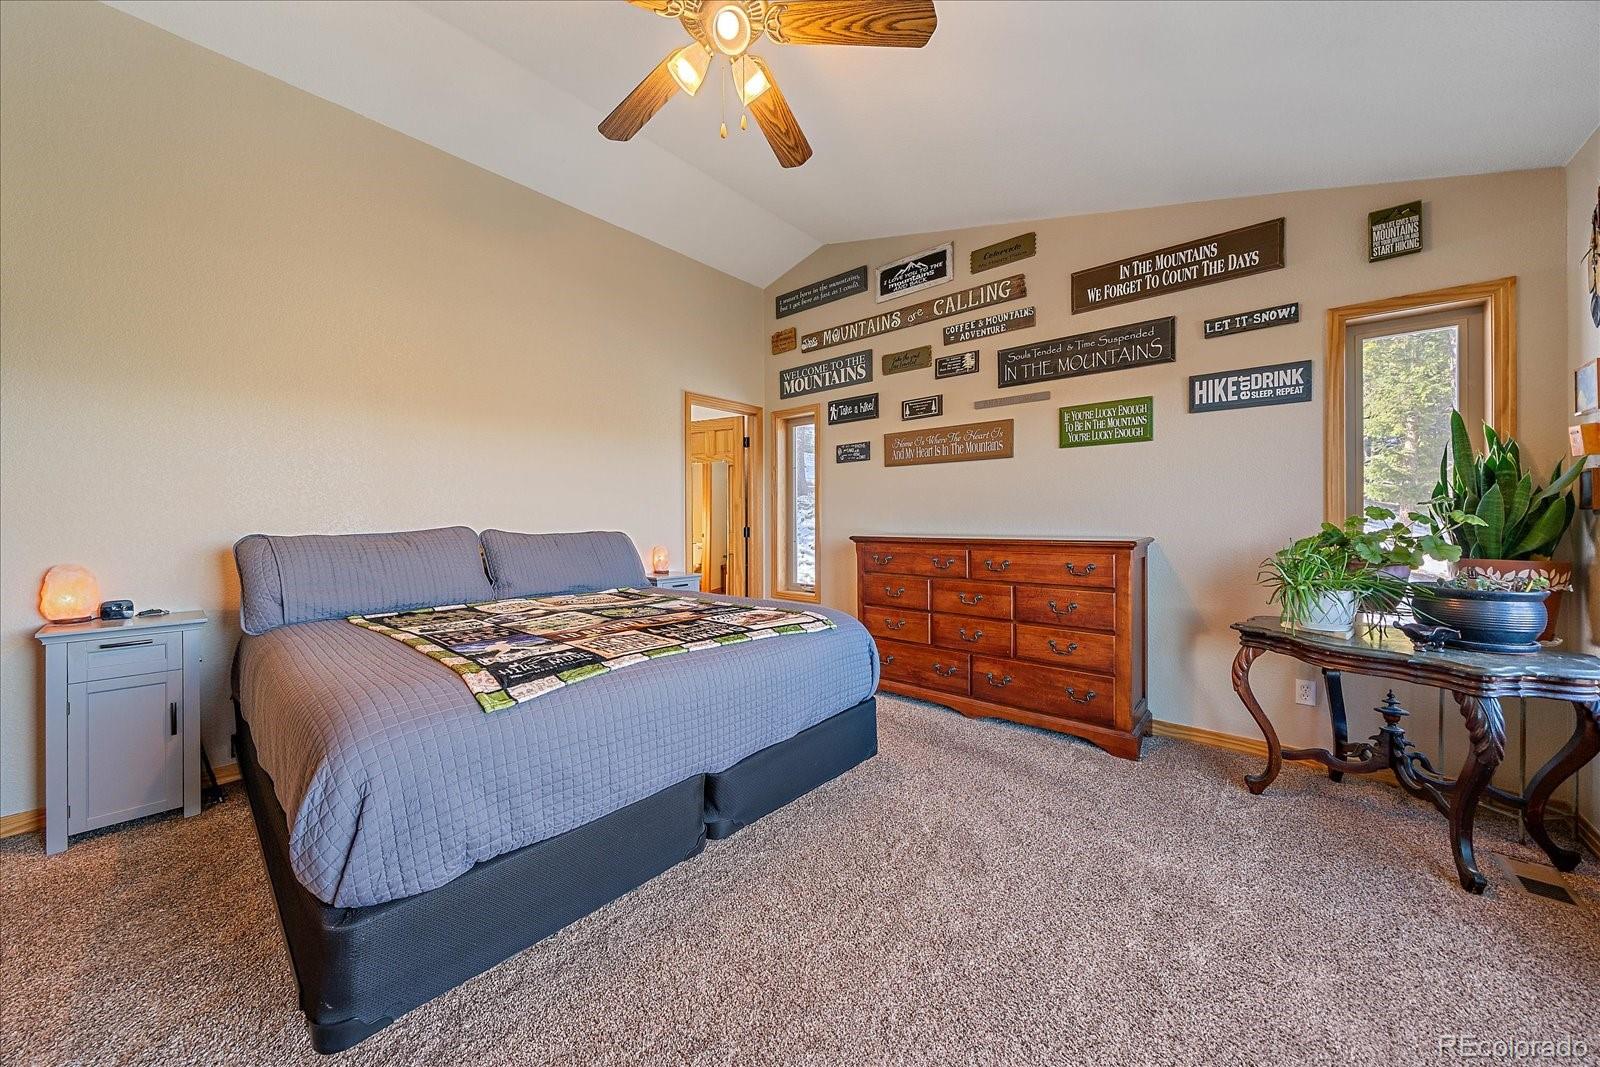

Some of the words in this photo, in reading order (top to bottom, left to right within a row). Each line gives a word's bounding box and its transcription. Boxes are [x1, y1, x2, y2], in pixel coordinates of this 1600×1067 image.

[1373, 222, 1419, 242] MOUNTAINS
[1119, 264, 1130, 280] IN
[1133, 259, 1153, 277] THE
[1155, 242, 1218, 270] MOUNTAINS
[1373, 243, 1394, 257] START
[1395, 238, 1420, 252] HIKING
[889, 270, 935, 289] mountains
[1087, 287, 1102, 303] WE
[1104, 278, 1143, 300] FORGET
[1145, 274, 1160, 290] TO
[1162, 264, 1200, 286] COUNT
[1202, 258, 1225, 277] THE
[1228, 250, 1260, 272] DAYS
[801, 336, 818, 351] The
[823, 311, 901, 346] MOUNTAINS
[907, 307, 924, 323] are
[933, 280, 1012, 316] CALLING
[945, 320, 976, 335] COFFEE
[978, 320, 984, 328] &
[986, 307, 1034, 326] MOUNTAINS
[1206, 318, 1231, 333] LET
[1235, 315, 1249, 328] IT
[1253, 305, 1296, 324] SNOW!
[1007, 352, 1031, 364] Souls
[1031, 343, 1062, 357] Tended
[1066, 343, 1074, 352] &
[1075, 340, 1096, 351] Time
[1098, 326, 1155, 347] Suspended
[783, 363, 829, 381] WELCOME
[830, 359, 844, 371] TO
[845, 354, 866, 367] THE
[1004, 364, 1017, 382] IN
[1021, 360, 1054, 379] THE
[1058, 337, 1163, 373] MOUNTAINS
[783, 363, 867, 395] MOUNTAINS
[1195, 376, 1238, 405] HIKE
[1251, 367, 1304, 390] DRINK
[1276, 385, 1304, 397] REPEAT
[1064, 411, 1071, 422] IF
[1071, 410, 1094, 421] YOU'RE
[1095, 407, 1117, 419] LUCKY
[1118, 403, 1147, 416] ENOUGH
[1064, 422, 1074, 433] TO
[1074, 421, 1084, 432] BE
[1084, 420, 1092, 431] IN
[1093, 419, 1106, 430] THE
[1107, 415, 1147, 428] MOUNTAINS
[1068, 432, 1091, 443] YOU'RE
[1091, 429, 1114, 441] LUCKY
[1114, 427, 1144, 439] ENOUGH
[892, 449, 905, 461] And
[905, 447, 915, 461] My
[916, 445, 934, 458] Heart
[934, 444, 941, 456] Is
[942, 444, 949, 456] In
[951, 443, 964, 455] The
[965, 440, 1004, 454] Mountains
